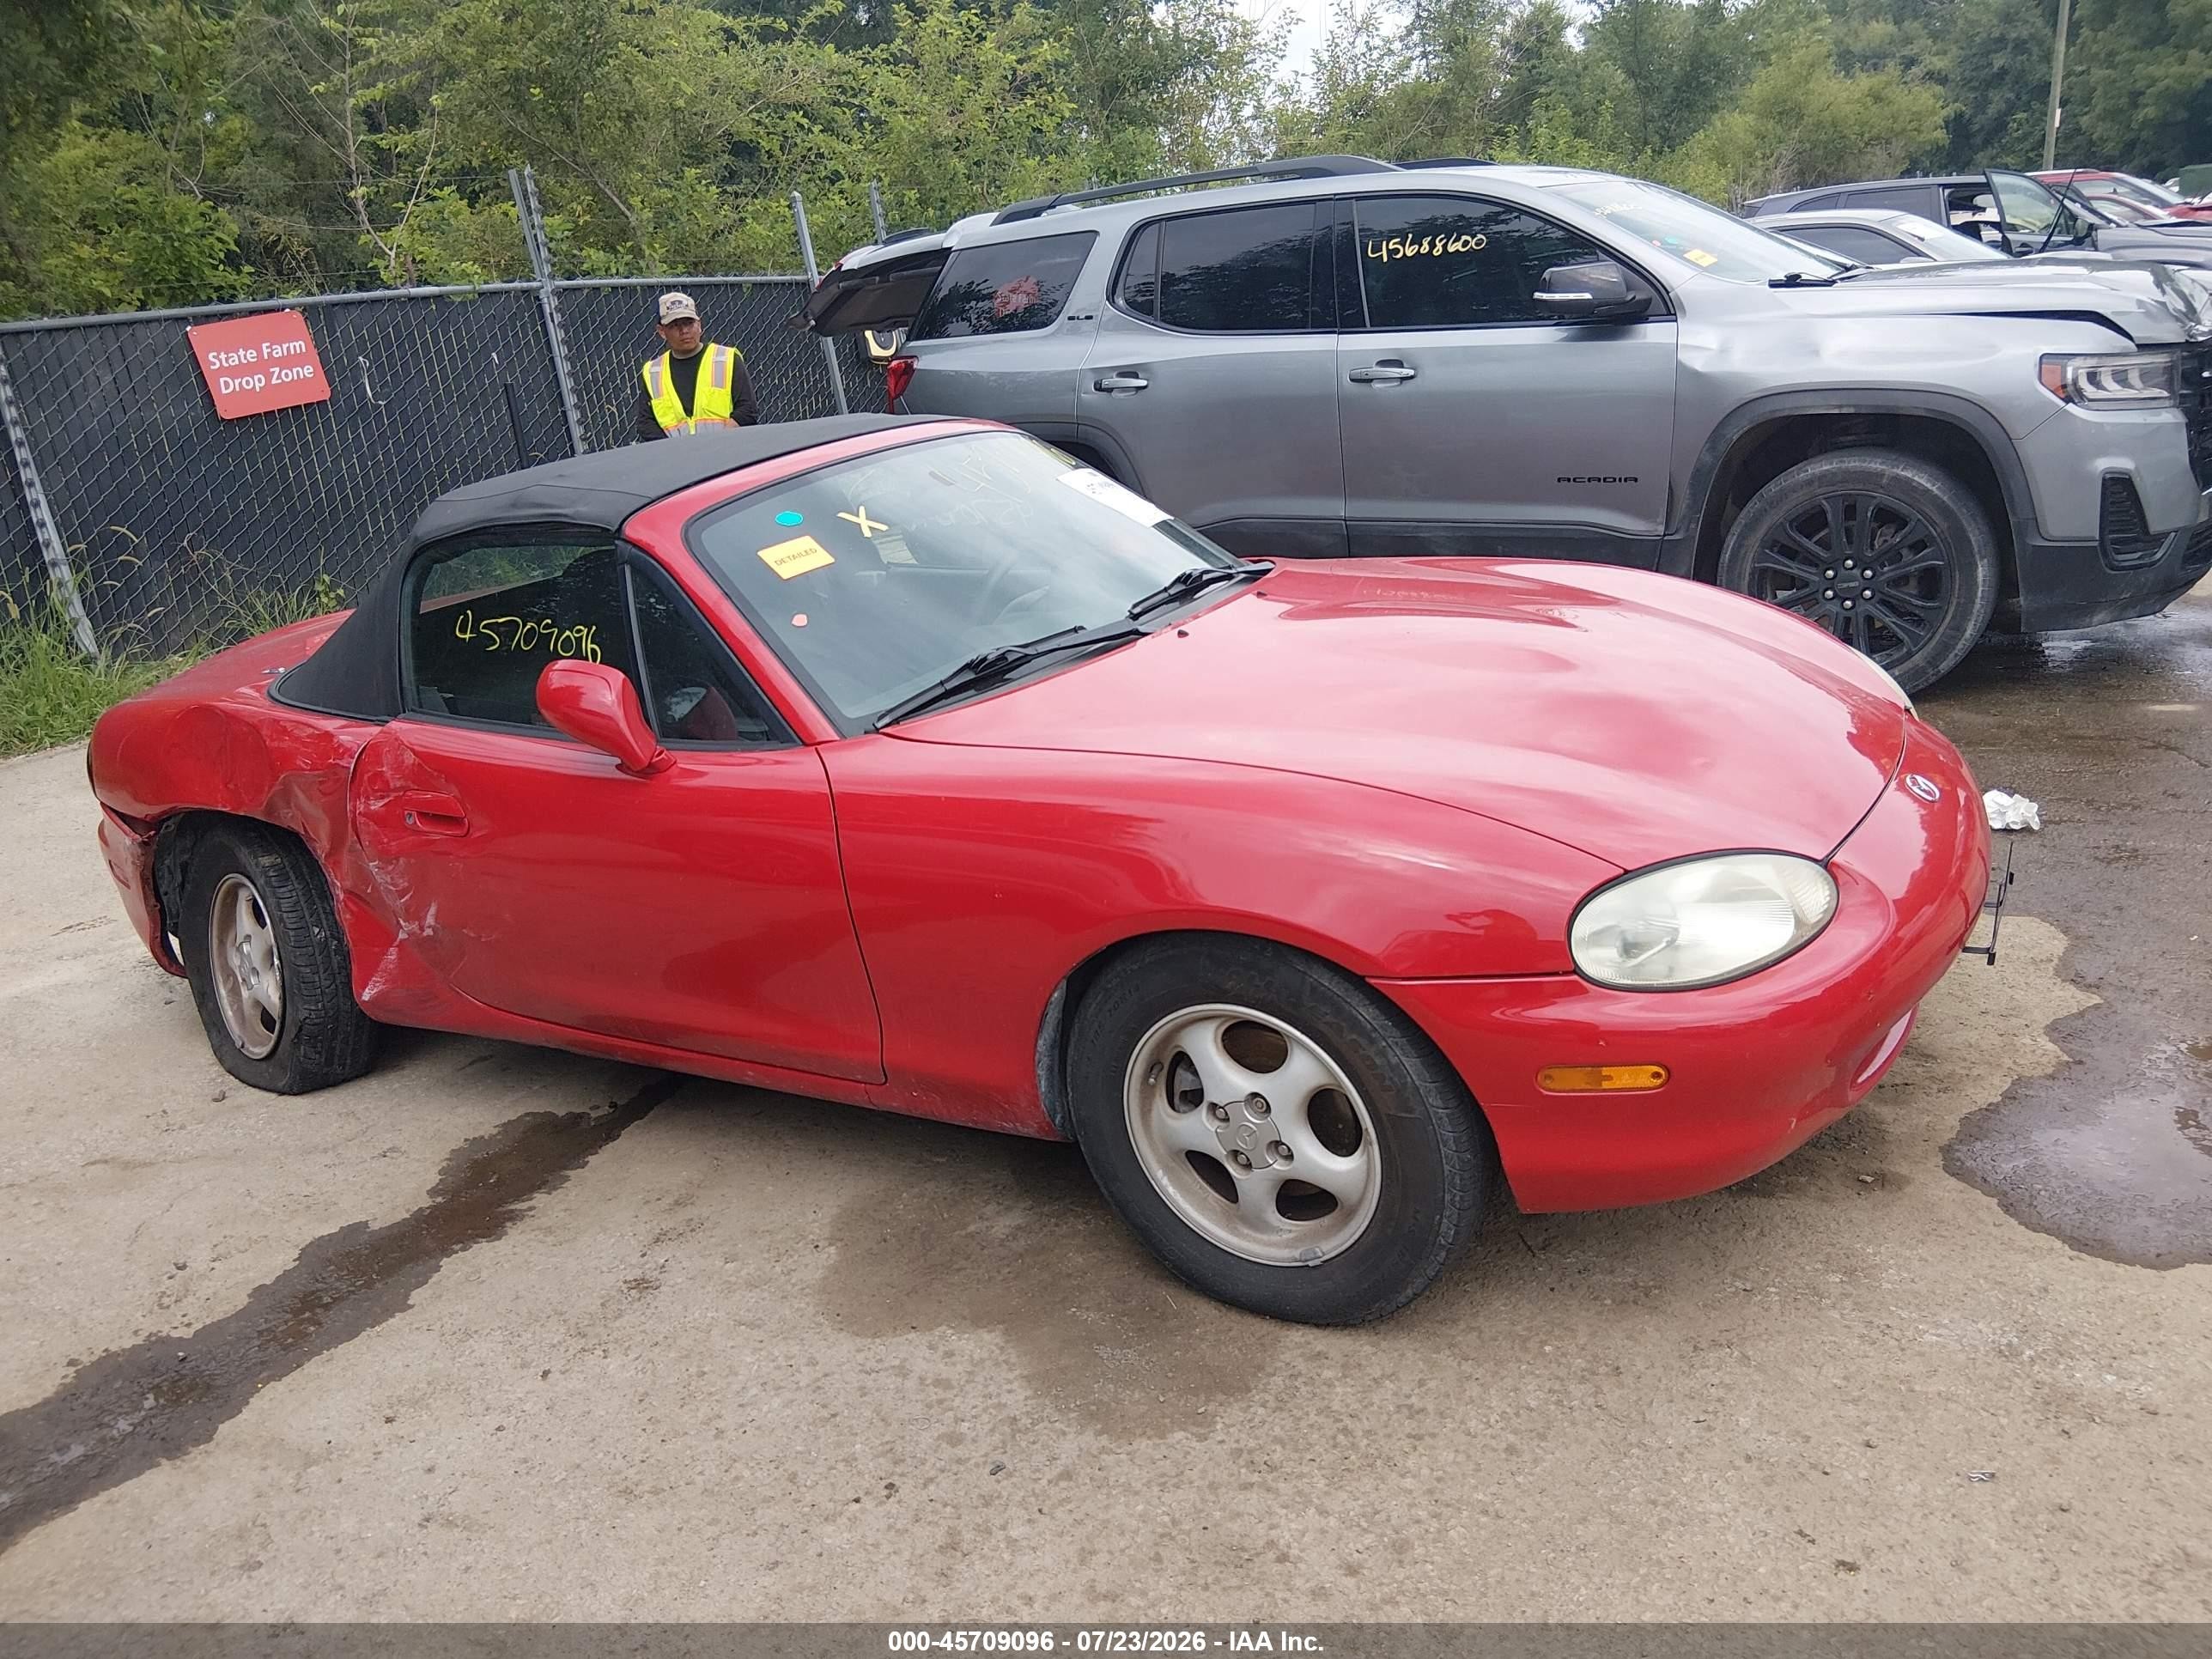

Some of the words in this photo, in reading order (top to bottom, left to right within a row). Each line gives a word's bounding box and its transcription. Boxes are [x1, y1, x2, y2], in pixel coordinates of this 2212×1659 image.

[1367, 232, 1487, 263] 45688600
[208, 348, 258, 370] State
[262, 340, 307, 360] Farm
[219, 373, 266, 395] Drop
[269, 364, 314, 385] Zone
[775, 548, 817, 567] DETAILED
[455, 610, 602, 665] 45709096
